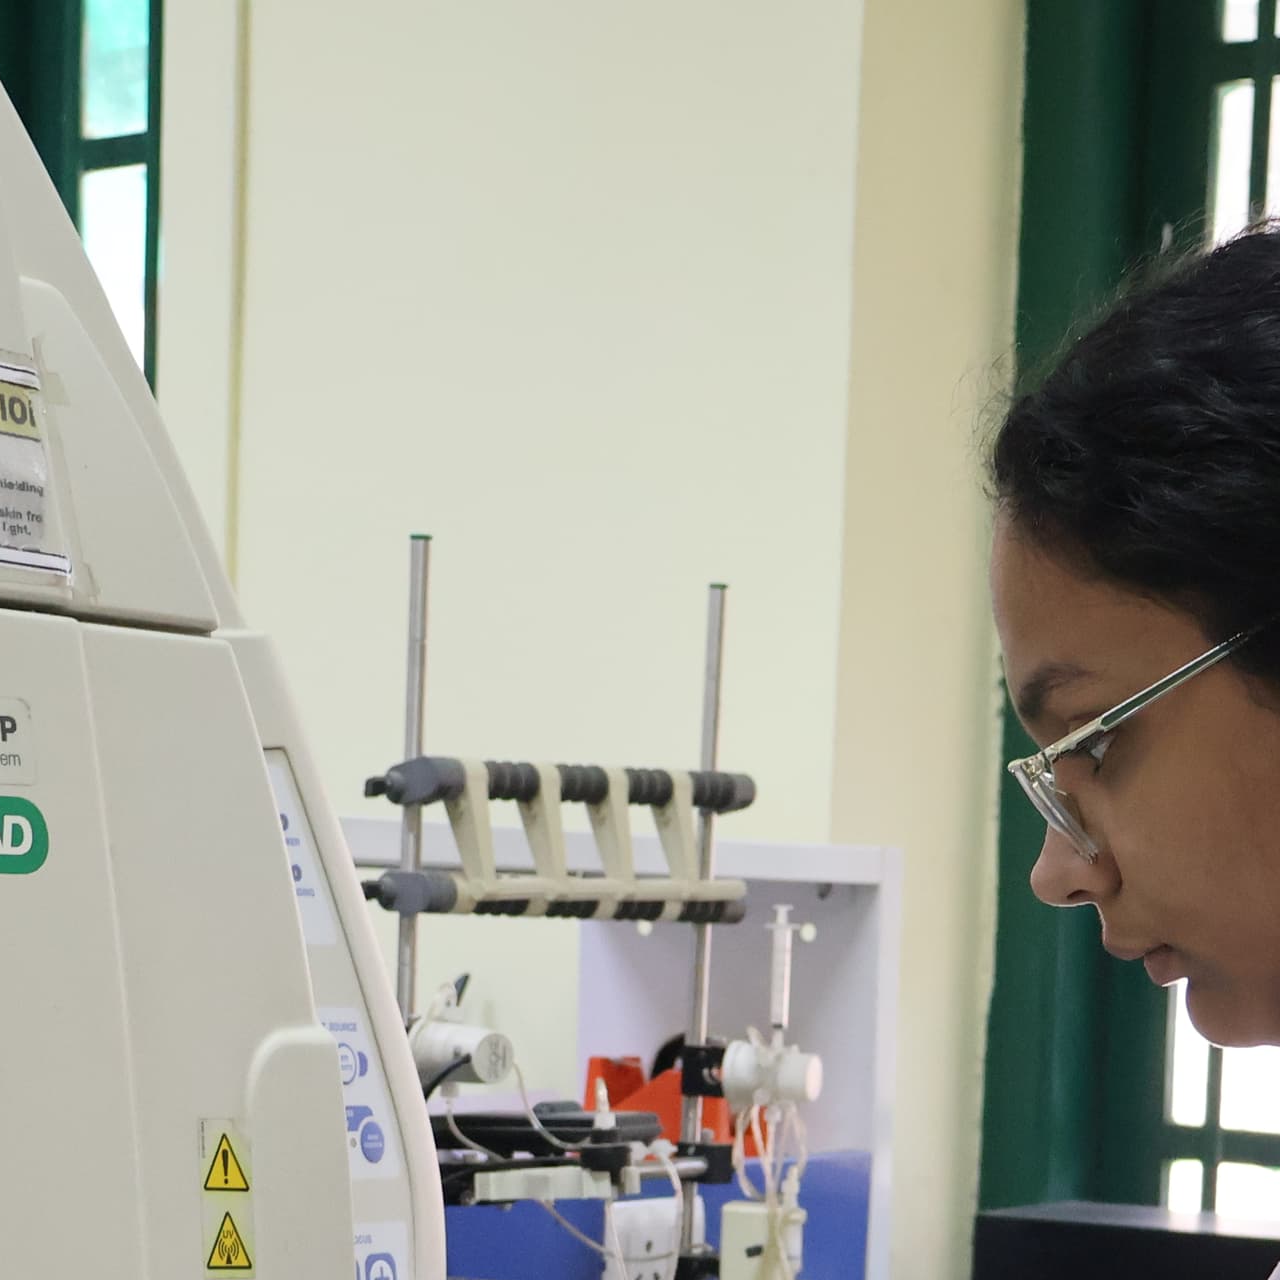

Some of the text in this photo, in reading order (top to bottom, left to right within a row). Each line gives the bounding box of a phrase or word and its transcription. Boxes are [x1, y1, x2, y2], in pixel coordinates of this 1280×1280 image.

[0, 506, 23, 520] skin
[26, 511, 43, 523] fro
[2, 522, 31, 536] lght.
[222, 1229, 234, 1239] UV
